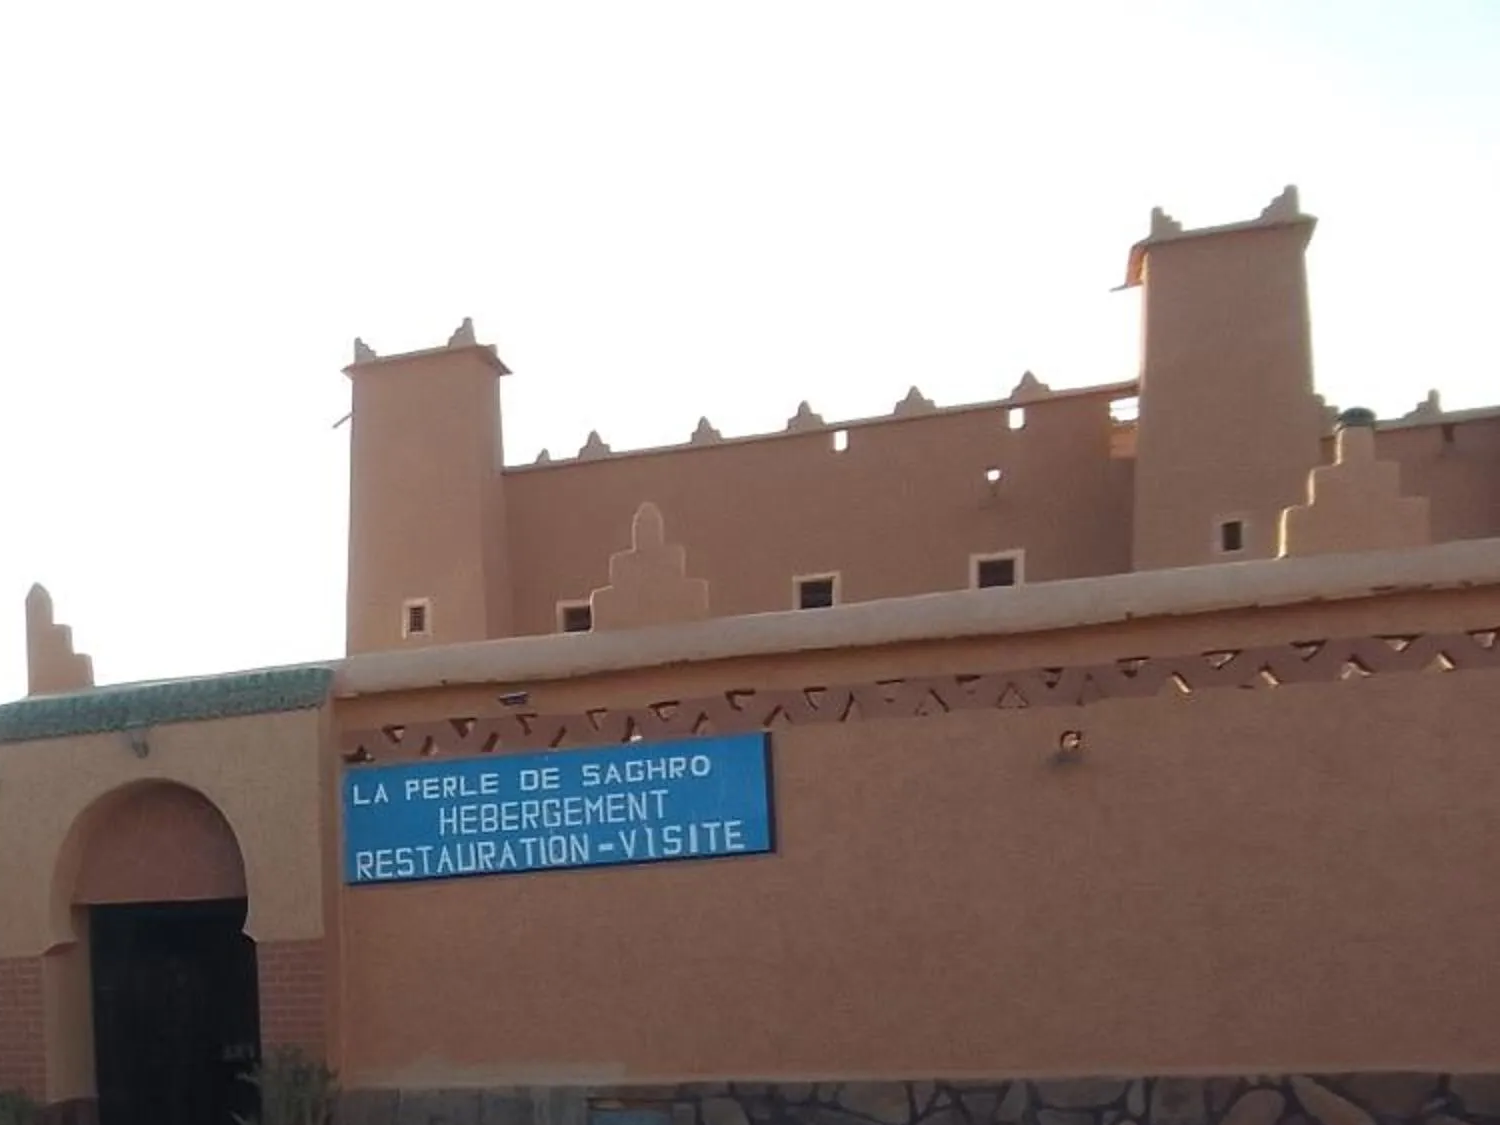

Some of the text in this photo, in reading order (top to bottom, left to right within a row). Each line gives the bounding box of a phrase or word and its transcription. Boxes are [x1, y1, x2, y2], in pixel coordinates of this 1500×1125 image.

[353, 755, 711, 806] LA PERLE DE SAGHRO
[438, 789, 669, 836] HEBERGEMENT
